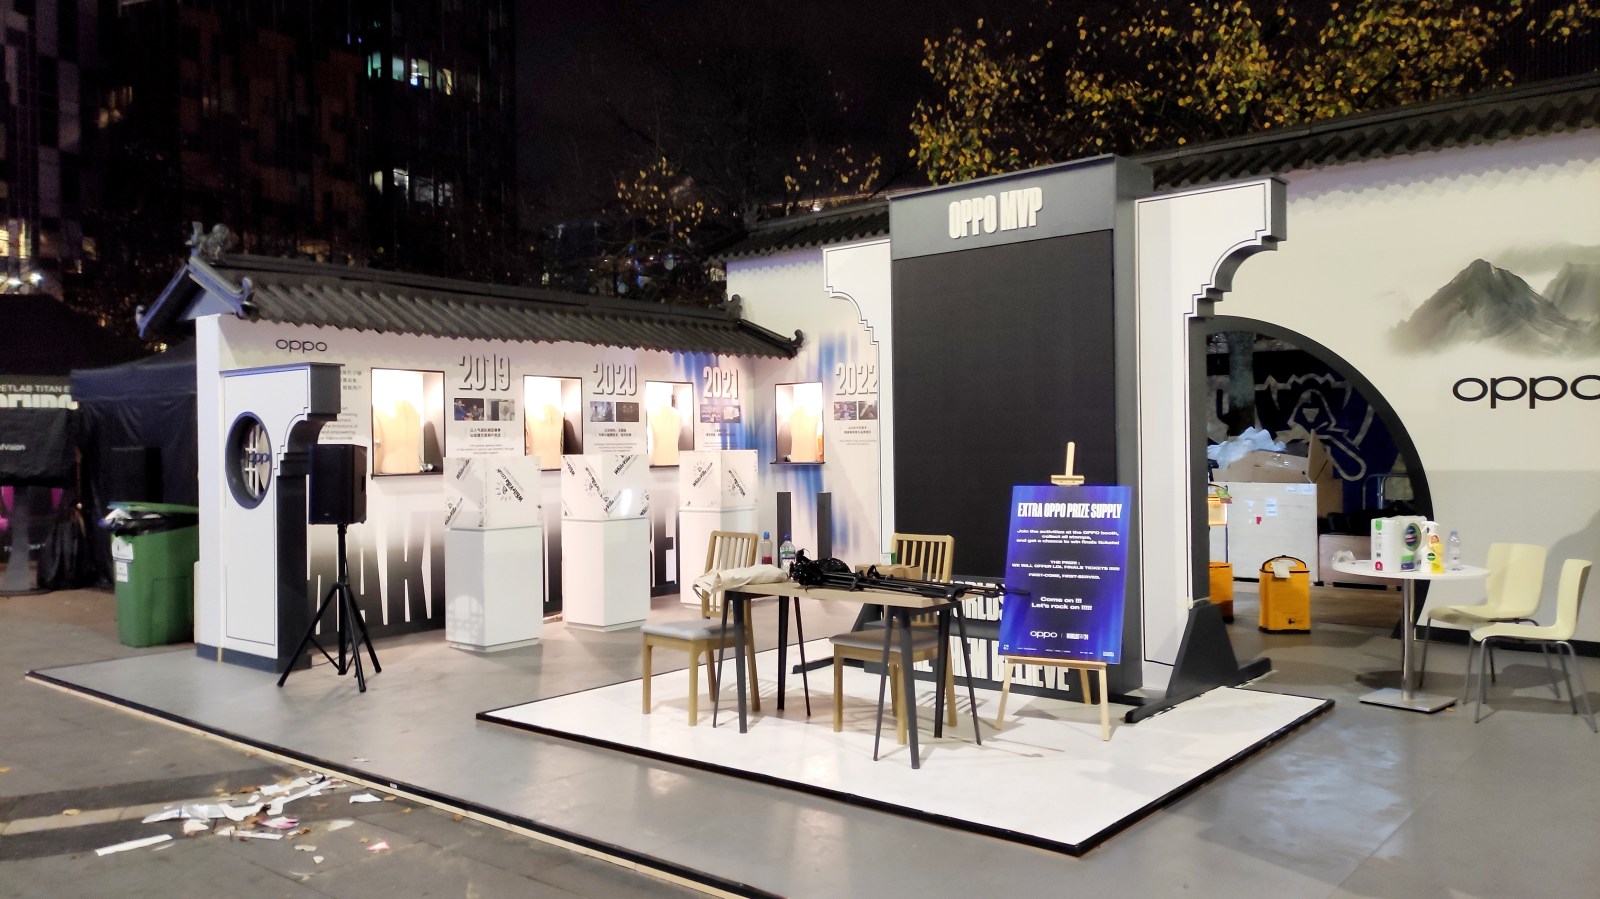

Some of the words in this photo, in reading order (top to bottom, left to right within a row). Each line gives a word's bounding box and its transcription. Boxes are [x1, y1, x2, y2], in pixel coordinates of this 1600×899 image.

[948, 195, 998, 239] OPPO
[1000, 186, 1043, 231] MVP
[276, 339, 327, 354] oppo
[35, 384, 62, 393] TITAN
[457, 353, 511, 392] 2019
[592, 361, 638, 396] 2020
[703, 365, 739, 400] 2021
[835, 362, 878, 396] 2022
[1452, 374, 1600, 409] oppo
[1017, 502, 1043, 518] EXTRA
[1043, 502, 1067, 518] OPPO
[1066, 503, 1090, 518] PRIZE
[1090, 503, 1122, 519] SUPPLY
[1030, 630, 1058, 639] oppo
